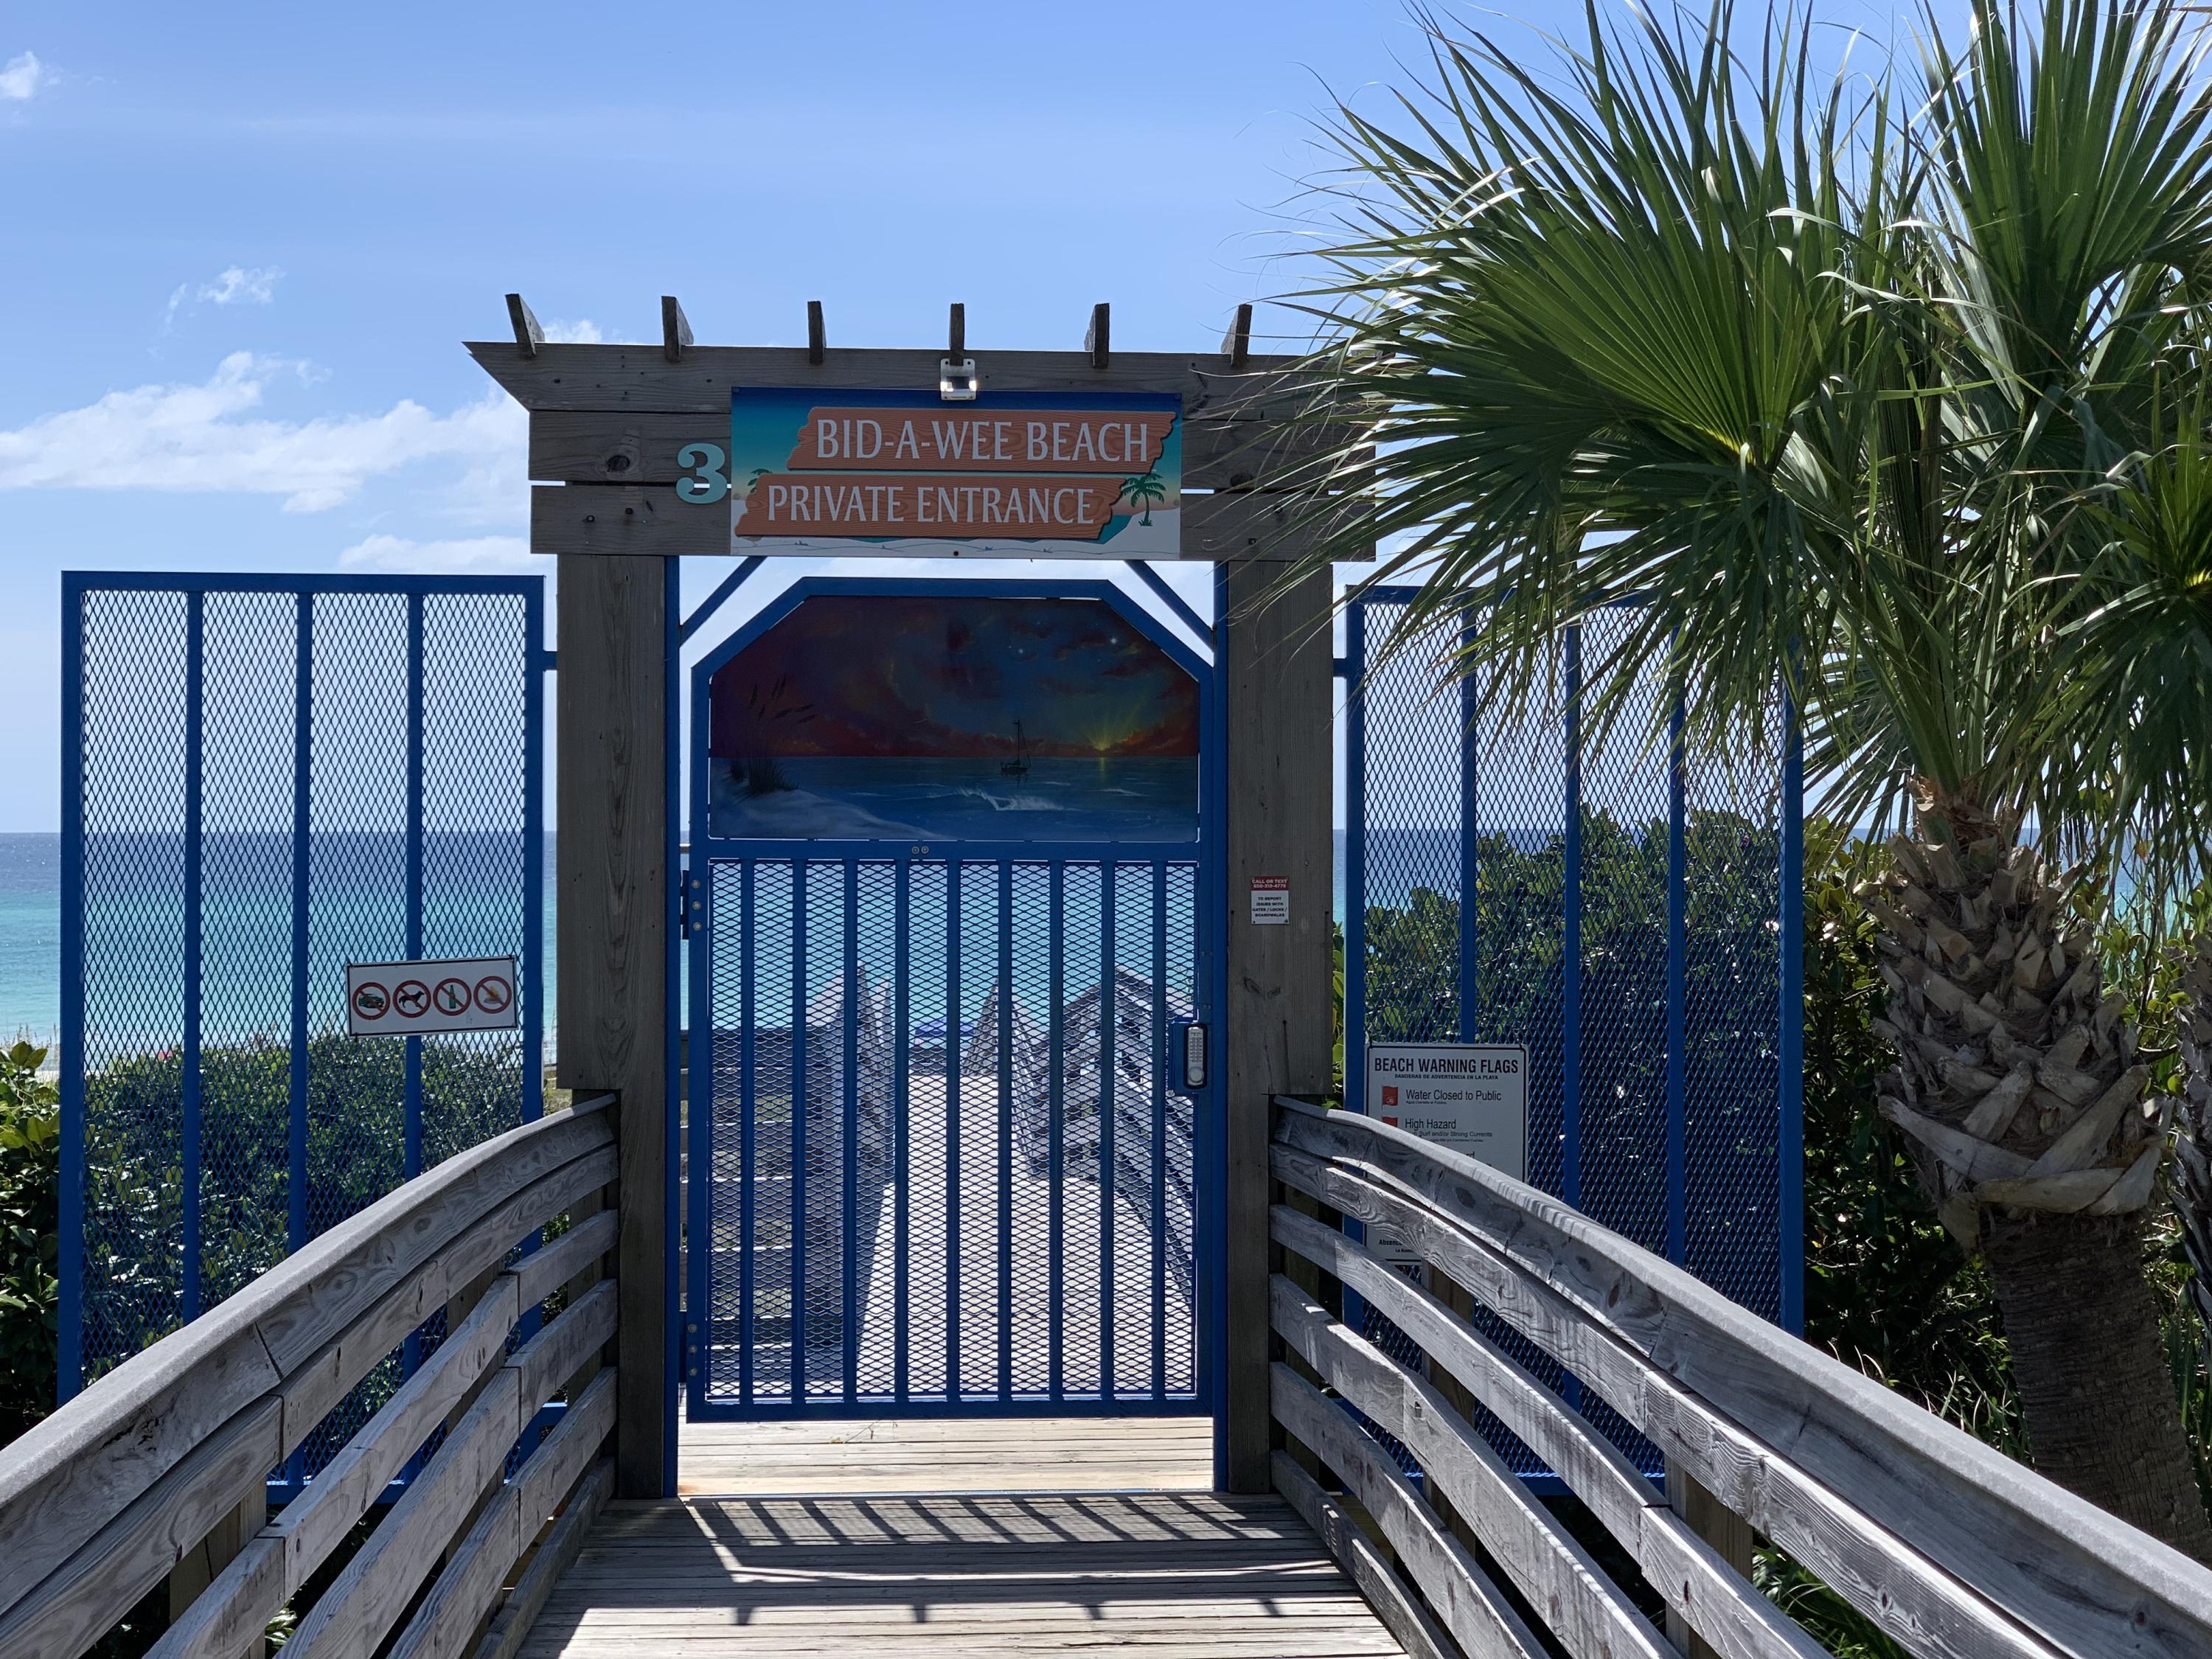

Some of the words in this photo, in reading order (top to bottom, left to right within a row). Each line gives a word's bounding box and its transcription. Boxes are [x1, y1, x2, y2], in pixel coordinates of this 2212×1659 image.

[816, 419, 1013, 461] BID-A-WEE
[1026, 422, 1150, 463] BEACH
[675, 442, 728, 505] 3
[768, 485, 905, 524] PRIVATE
[917, 487, 1095, 525] ENTRANCE
[1374, 1057, 1414, 1072] BEACH
[1419, 1058, 1476, 1073] WARNING
[1481, 1060, 1518, 1074] FLAGS
[1405, 1089, 1431, 1099] Water
[1433, 1090, 1462, 1100] Closed
[1465, 1091, 1473, 1101] to
[1476, 1091, 1502, 1101] Public
[1405, 1118, 1424, 1130] High
[1427, 1119, 1456, 1130] Hazard
